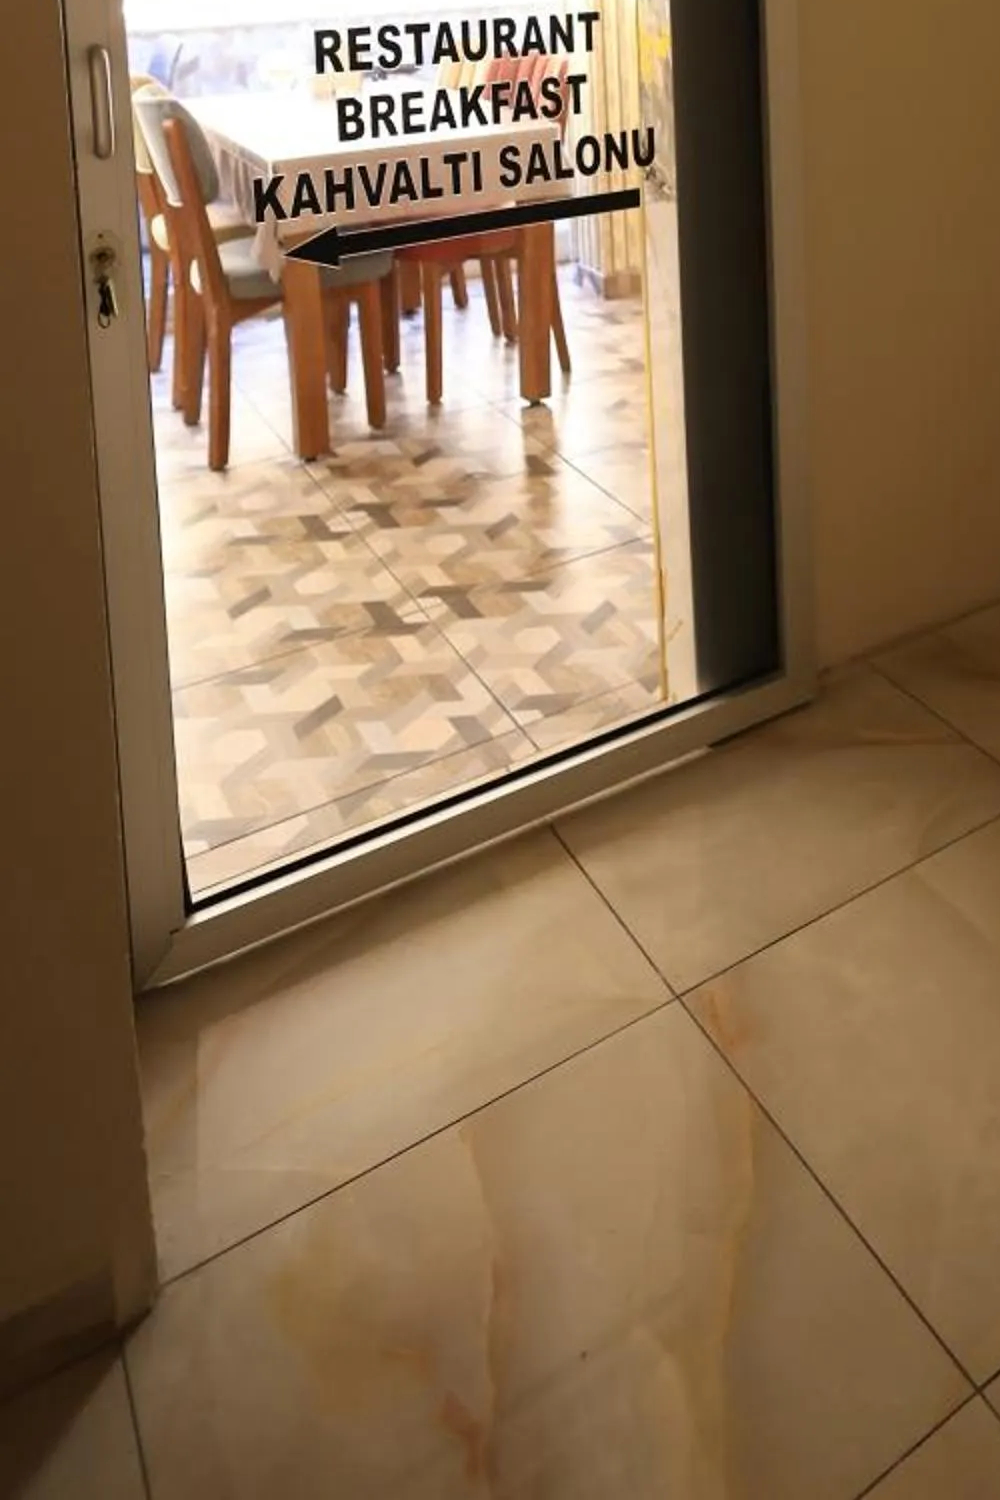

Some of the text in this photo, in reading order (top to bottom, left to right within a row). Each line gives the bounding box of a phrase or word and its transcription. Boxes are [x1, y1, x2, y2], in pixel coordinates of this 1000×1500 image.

[314, 11, 601, 75] RESTAURANT
[336, 74, 588, 142] BREAKFAST
[253, 127, 656, 224] KAHVALTI SALONU
